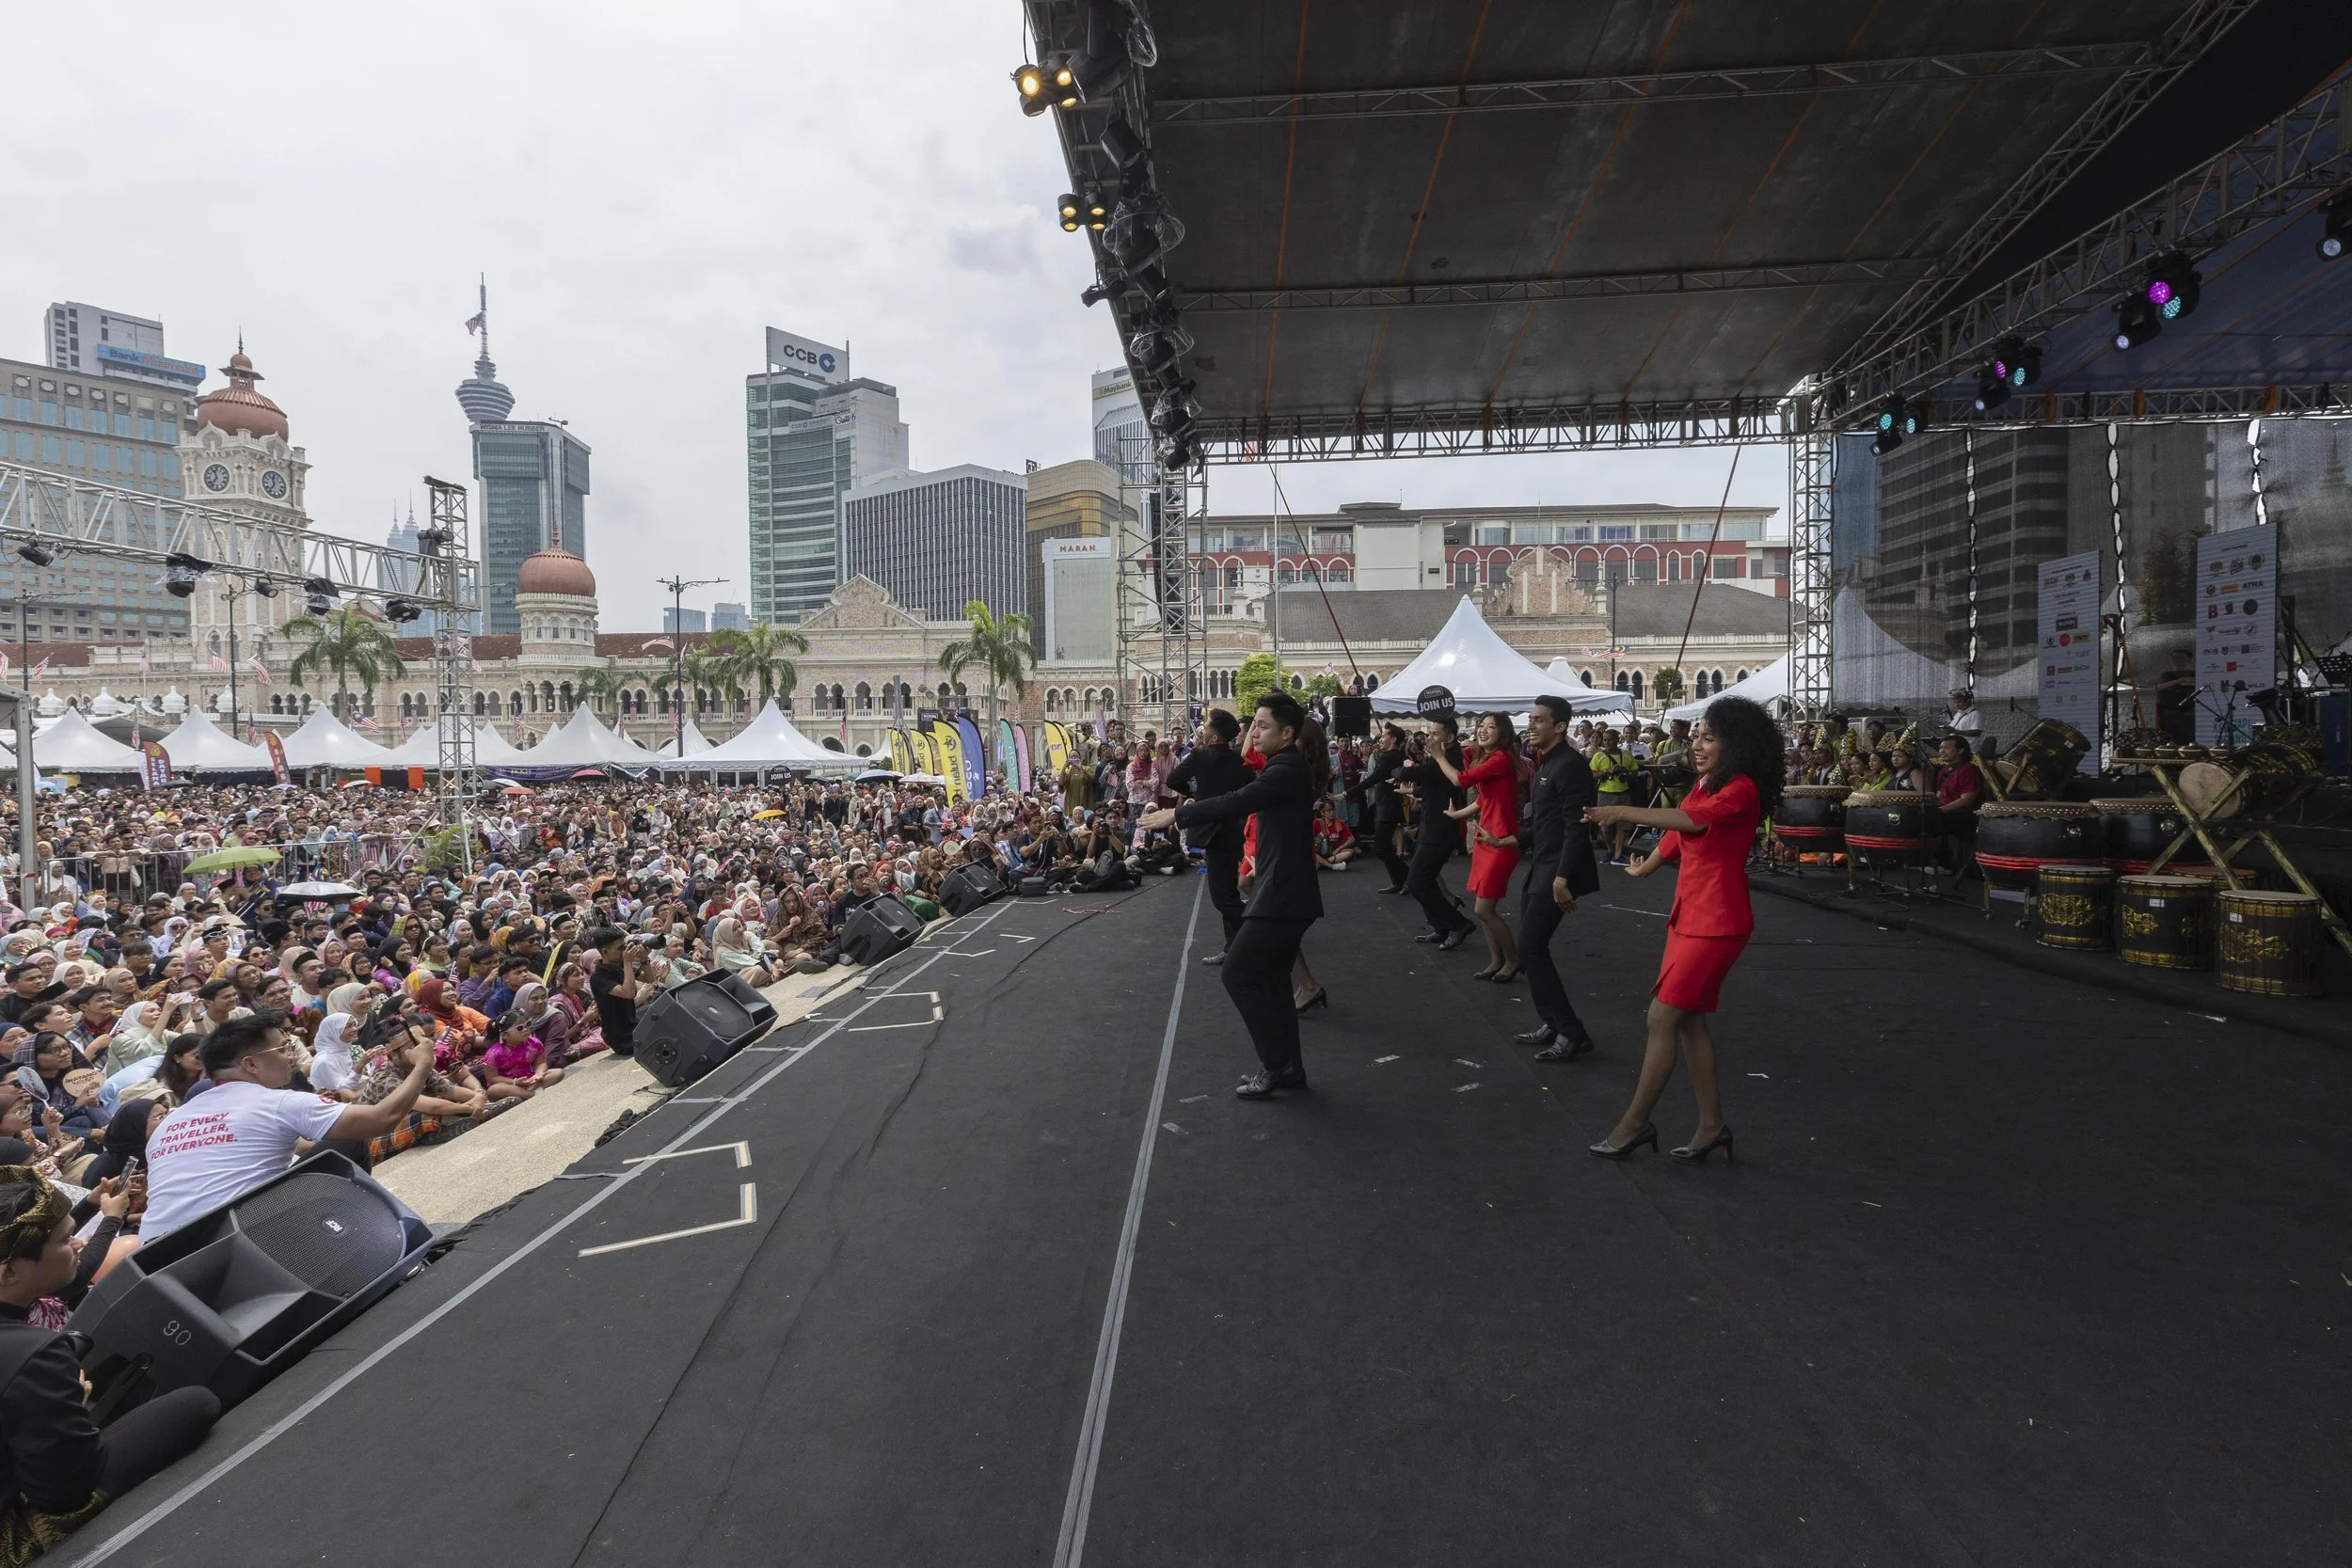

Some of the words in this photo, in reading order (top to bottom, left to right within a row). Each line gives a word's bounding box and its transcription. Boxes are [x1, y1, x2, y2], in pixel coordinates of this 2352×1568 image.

[109, 349, 140, 364] Bank
[783, 344, 818, 365] CCB
[1104, 380, 1132, 395] Maybank
[1419, 699, 1440, 713] JOIN
[1440, 697, 1454, 708] US
[771, 772, 783, 781] JOIN
[166, 1121, 186, 1134] FOR
[188, 1111, 230, 1129] EVERY
[159, 1123, 230, 1147] TRAVELLER,
[150, 1148, 167, 1162] FOR
[167, 1133, 239, 1155] EVERYONE.
[325, 1220, 343, 1232] RCF
